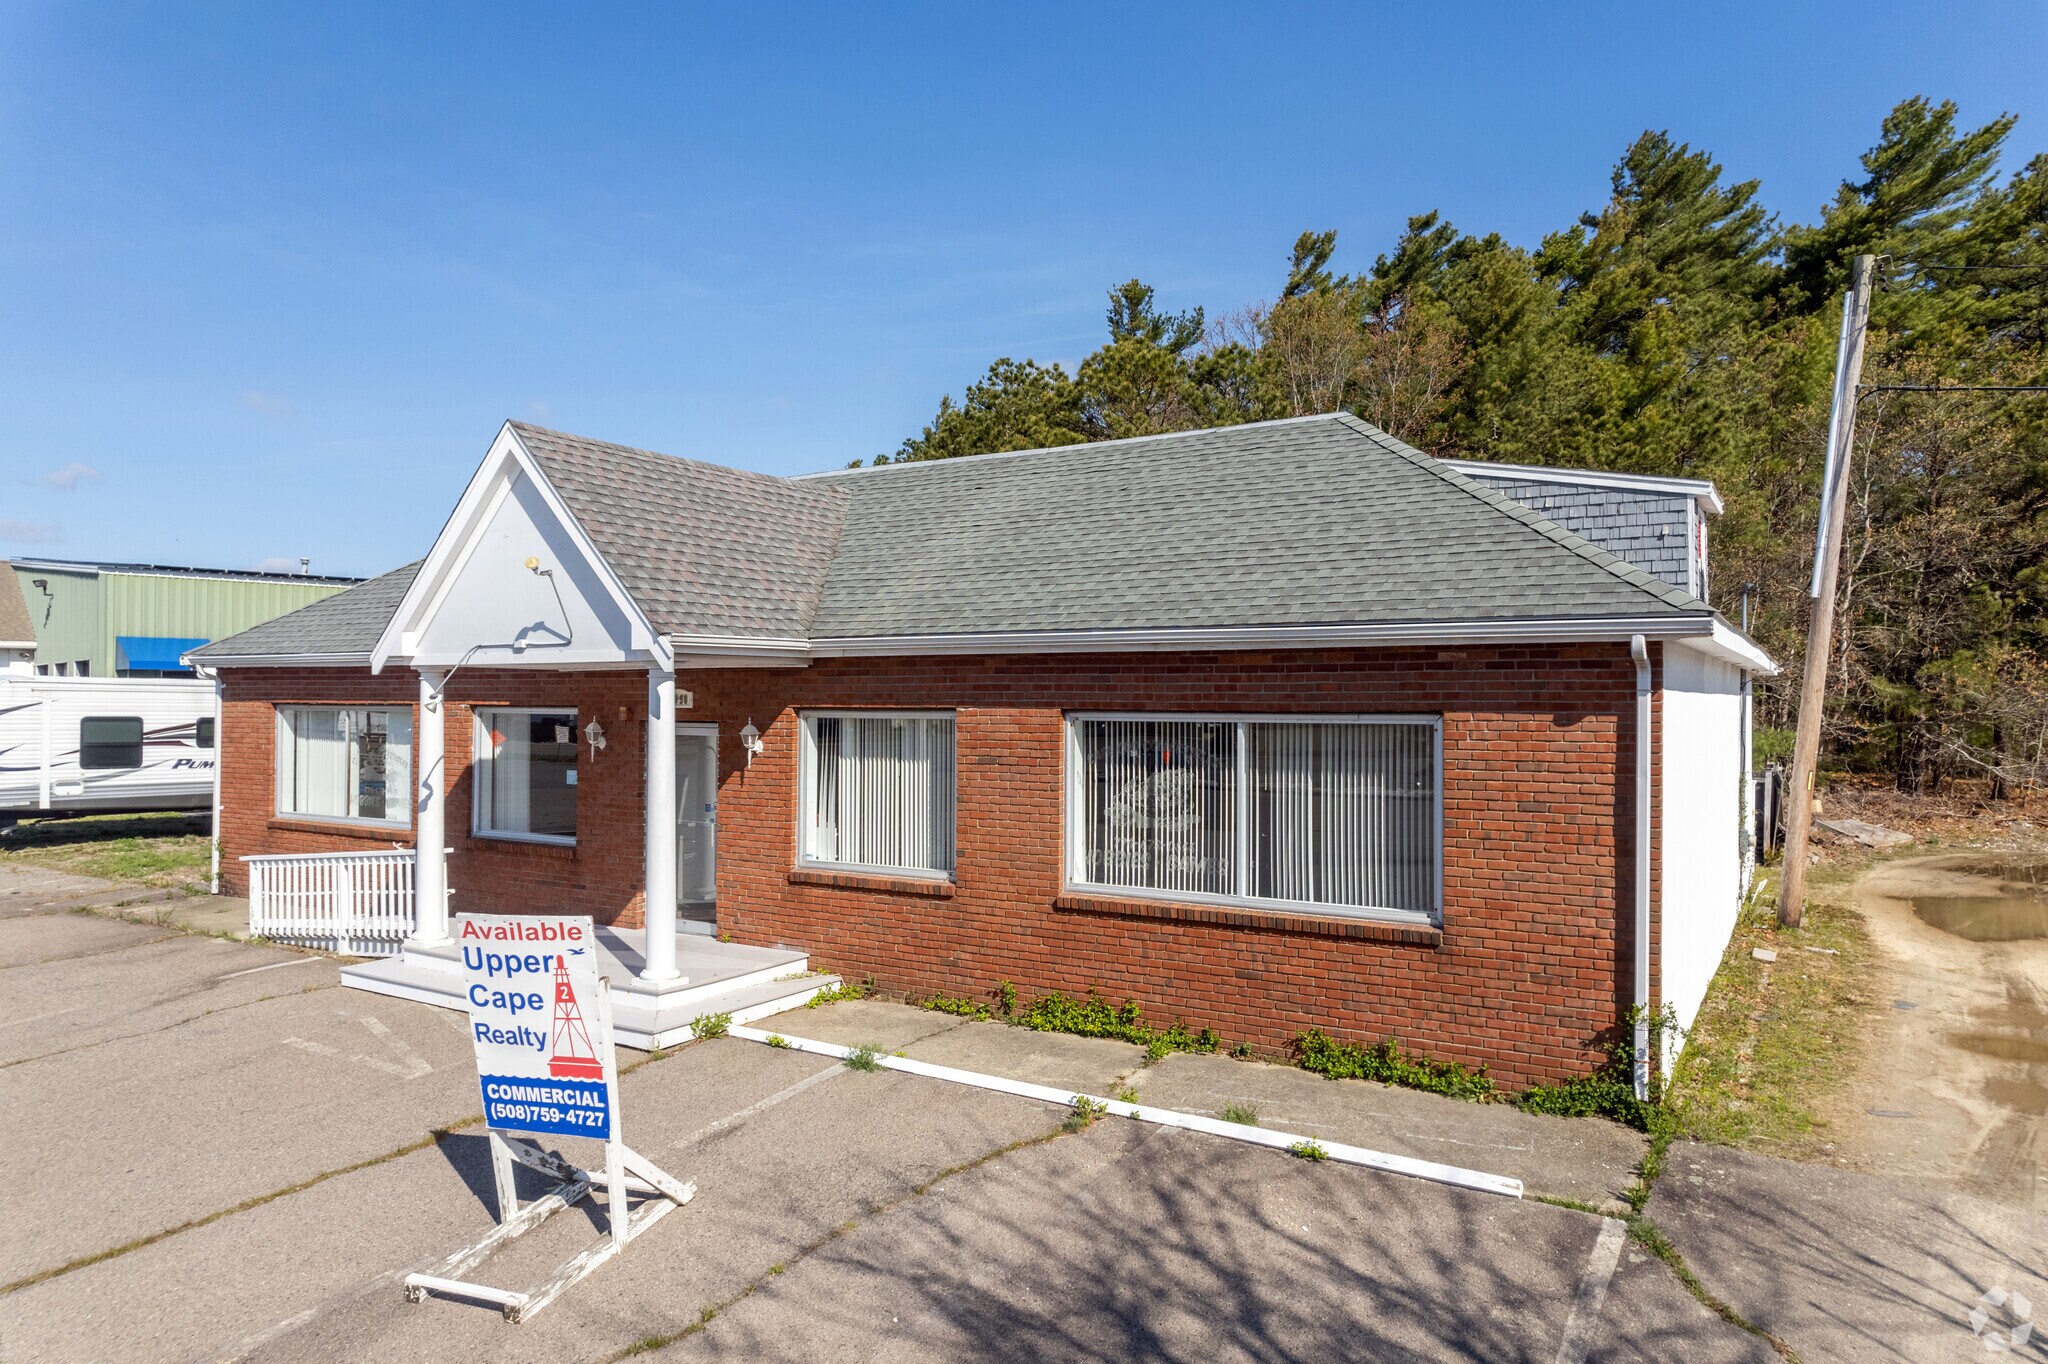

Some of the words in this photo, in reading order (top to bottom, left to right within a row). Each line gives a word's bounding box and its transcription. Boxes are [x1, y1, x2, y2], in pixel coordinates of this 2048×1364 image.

[461, 920, 583, 941] Available
[463, 946, 554, 978] Upper
[469, 984, 544, 1014] Cape
[559, 985, 570, 1000] 2
[474, 1023, 547, 1052] Realty
[487, 1083, 605, 1107] COMMERCIAL
[491, 1102, 605, 1127] (508)759-4727
